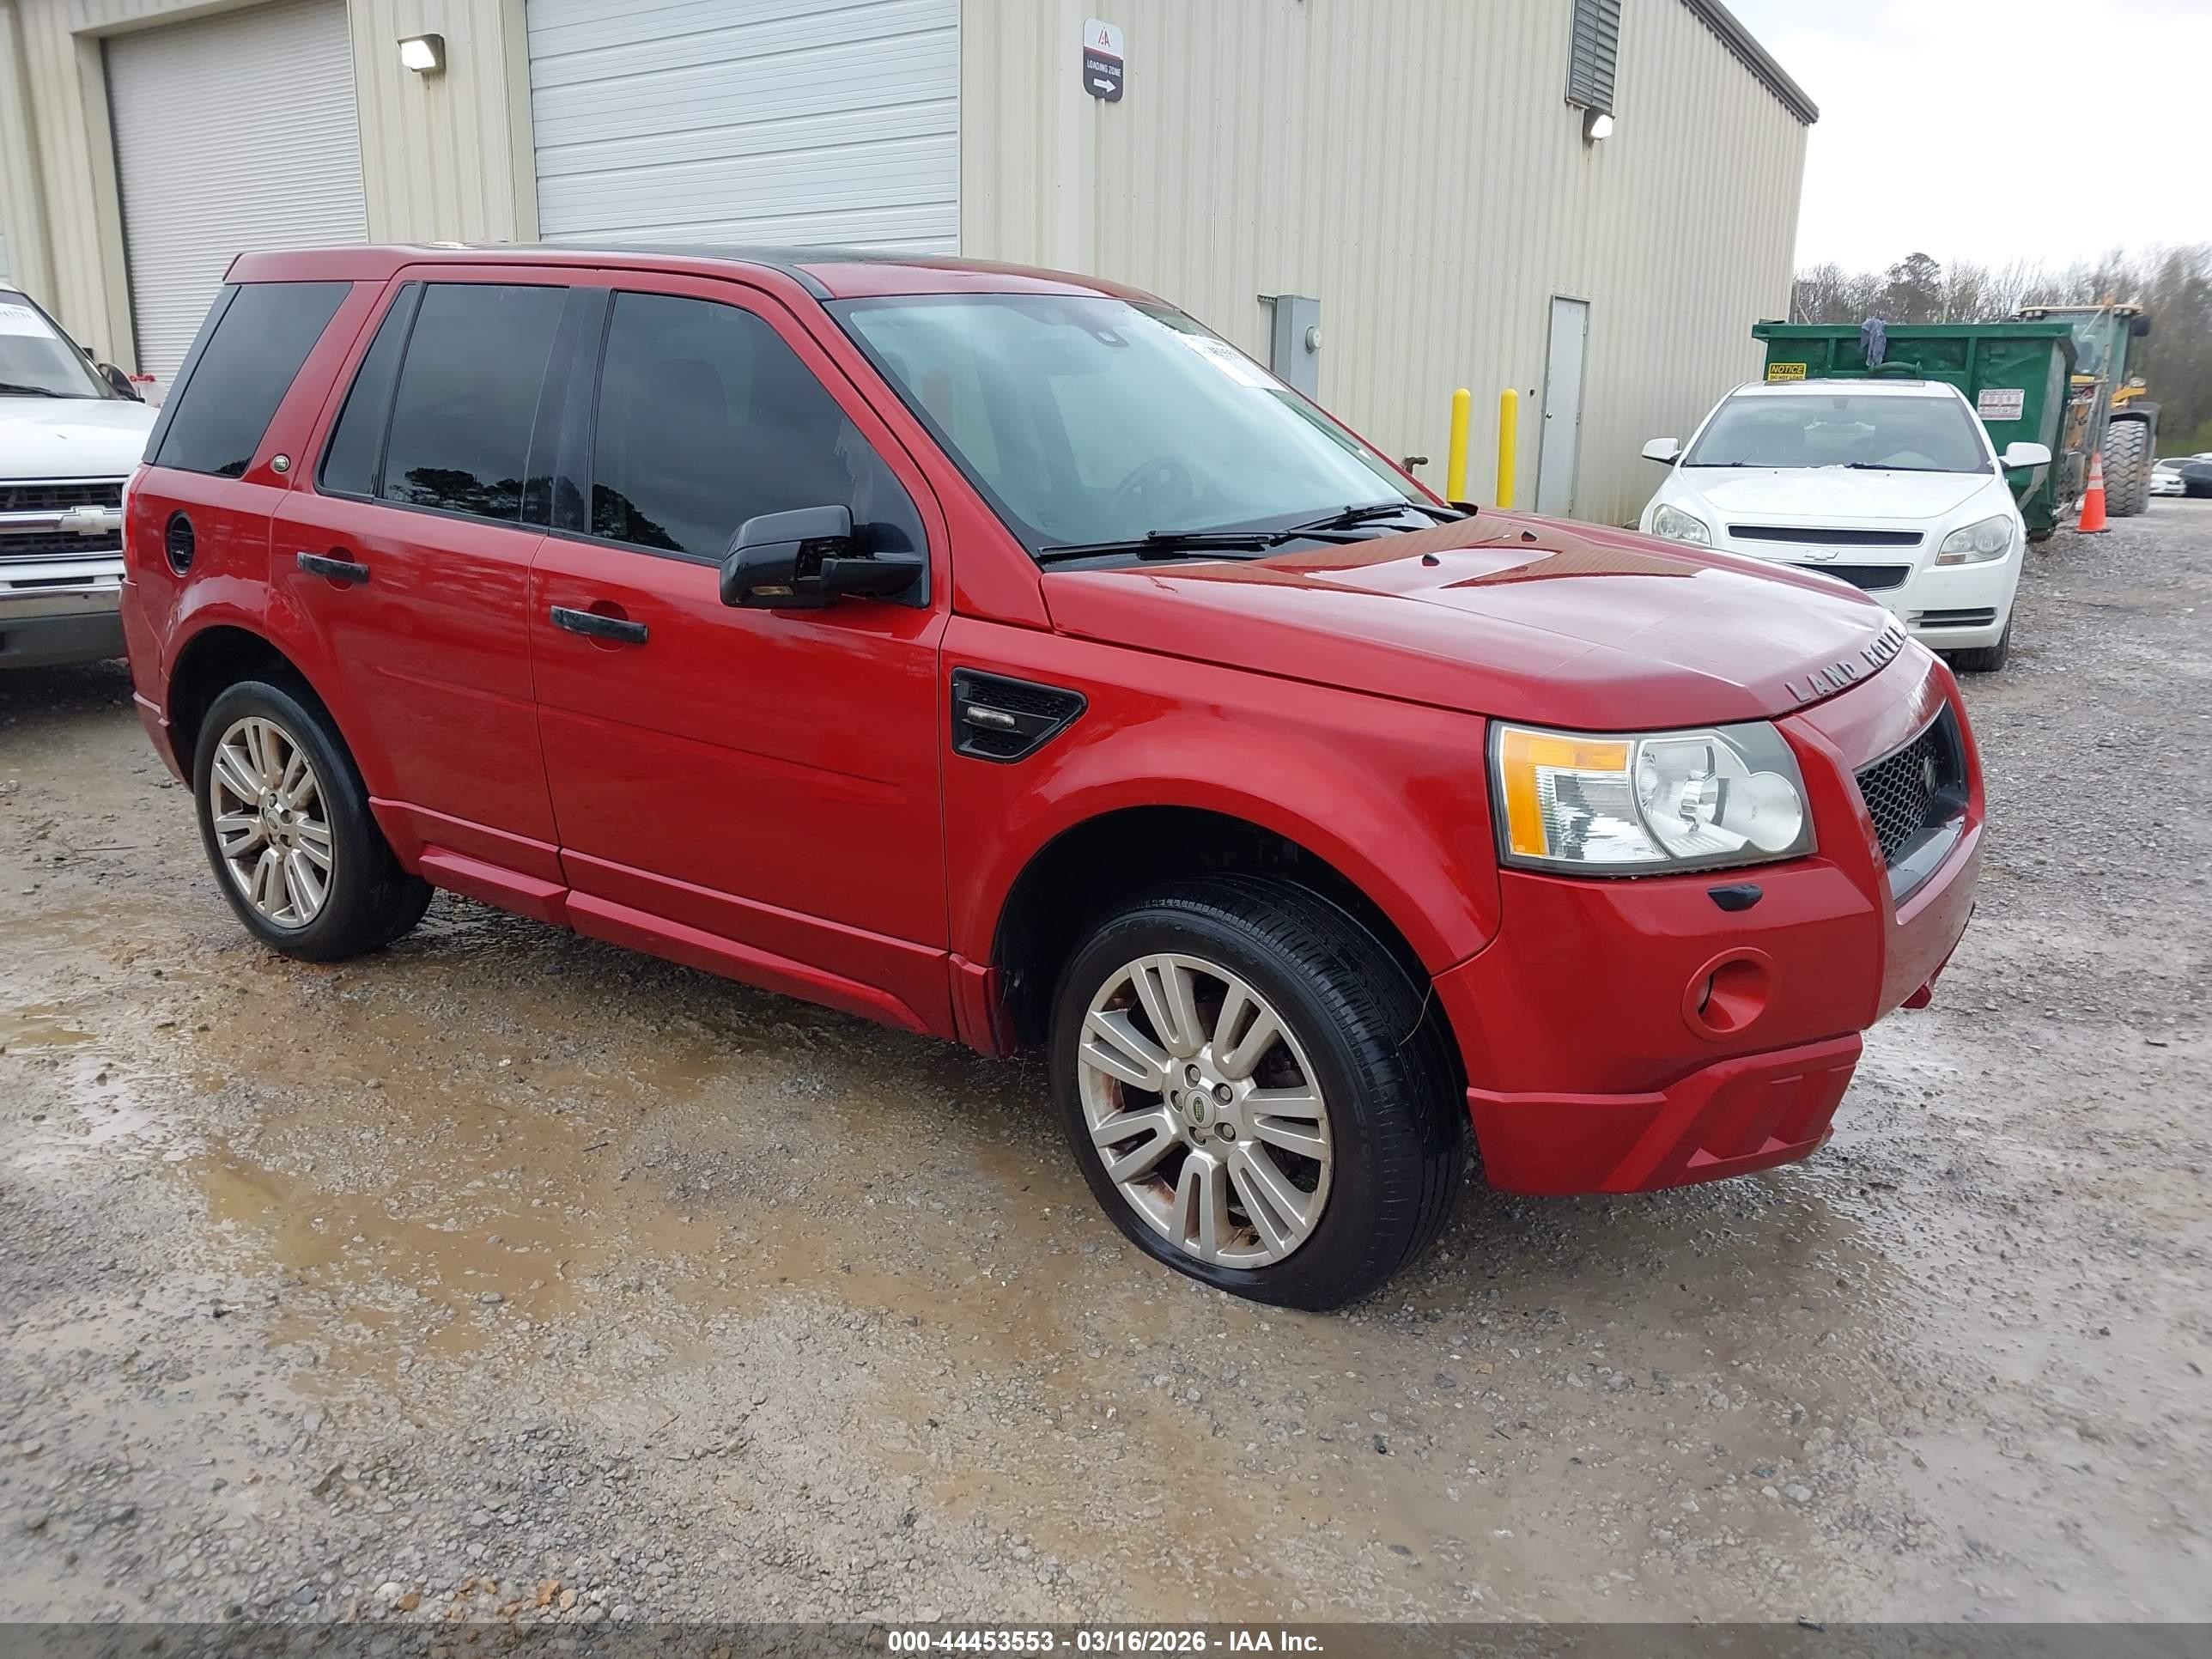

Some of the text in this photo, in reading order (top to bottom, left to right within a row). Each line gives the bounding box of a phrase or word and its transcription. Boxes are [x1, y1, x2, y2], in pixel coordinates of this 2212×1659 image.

[1086, 58, 1121, 78] LOADING ZONE
[1771, 365, 1804, 374] NOTICE
[1784, 660, 1860, 702] LAND
